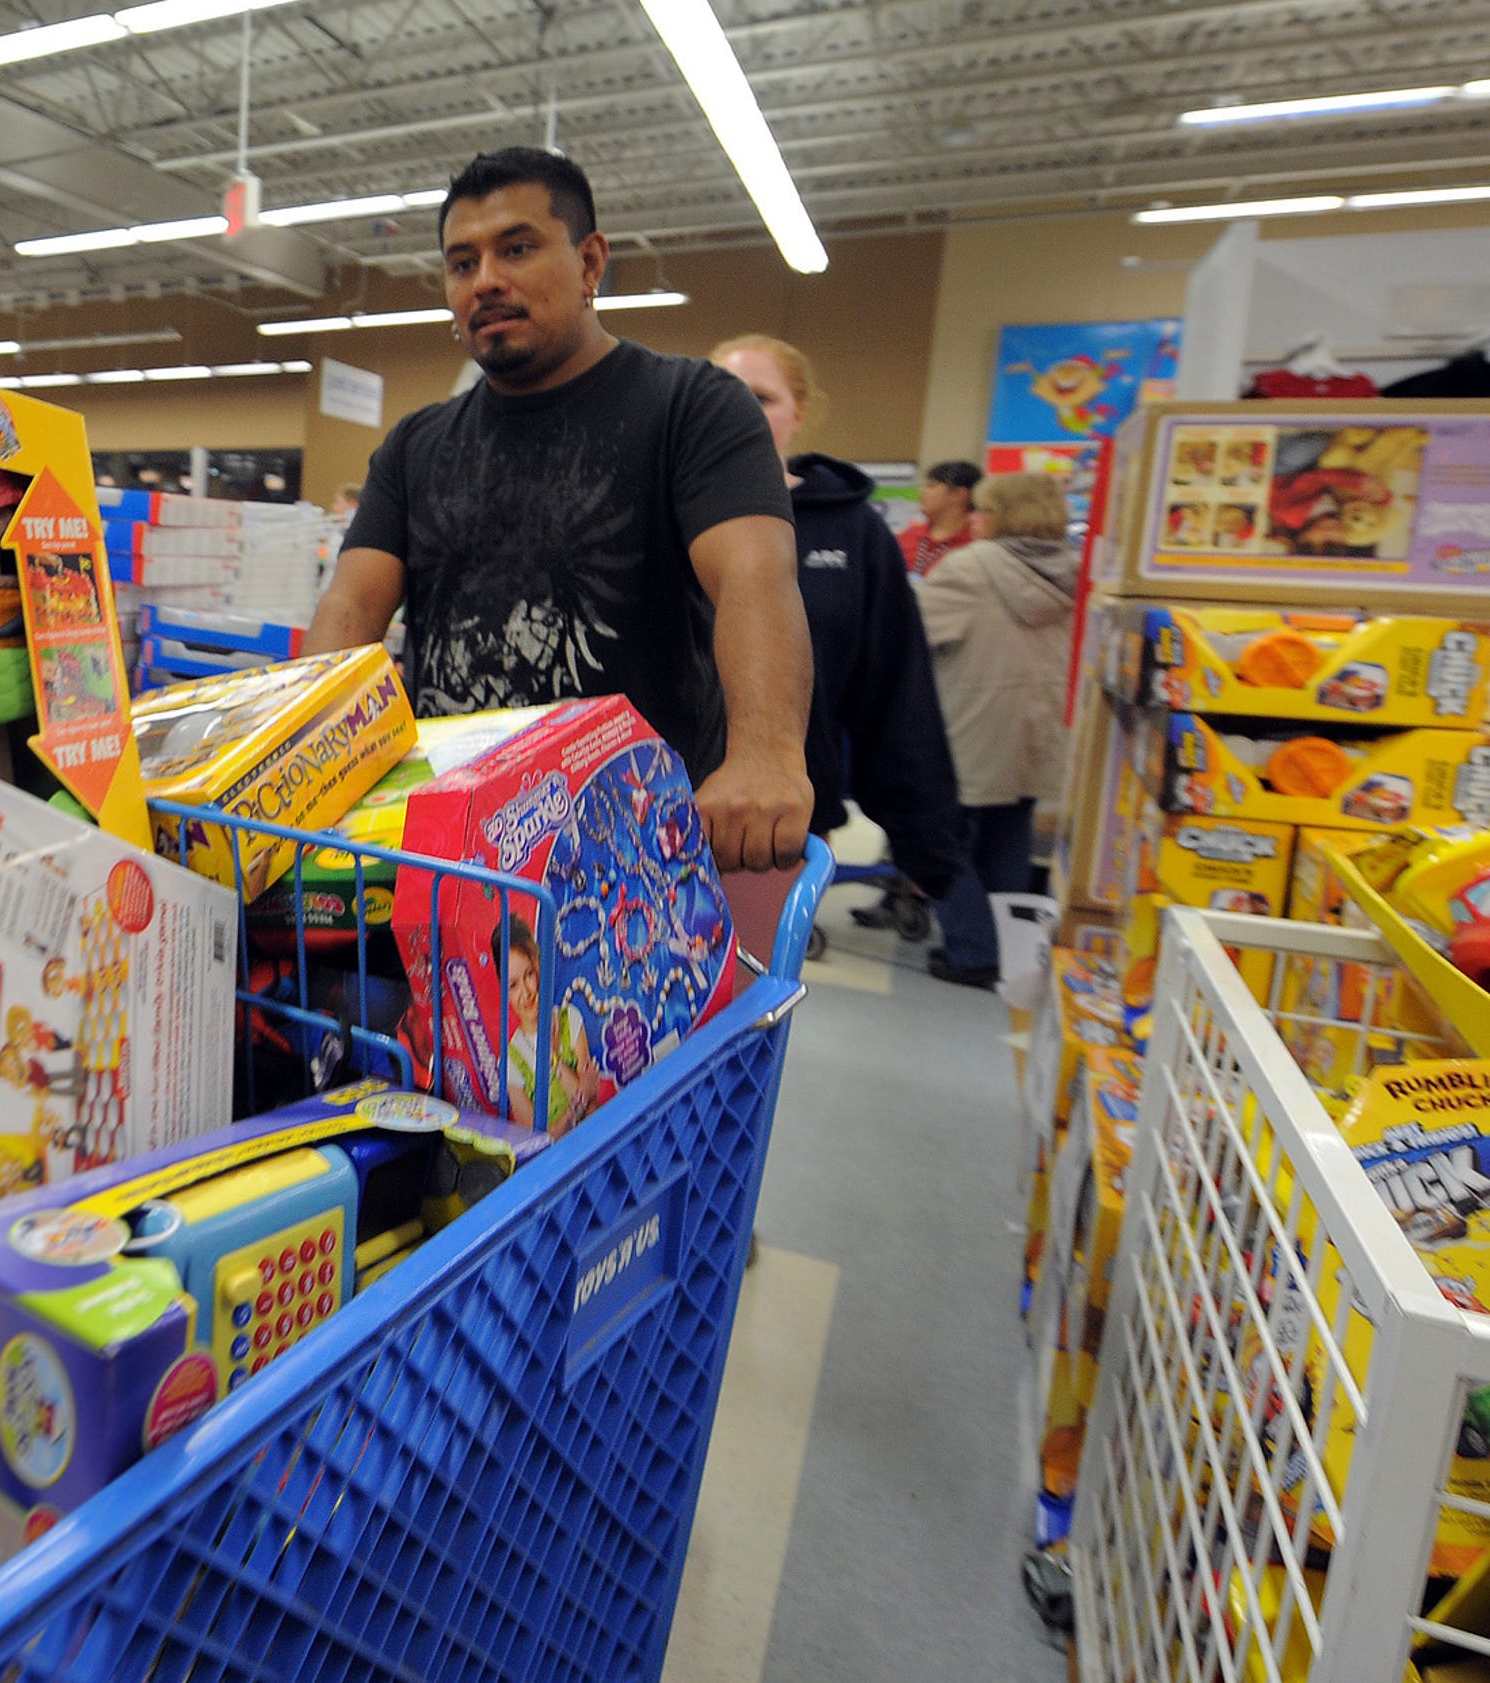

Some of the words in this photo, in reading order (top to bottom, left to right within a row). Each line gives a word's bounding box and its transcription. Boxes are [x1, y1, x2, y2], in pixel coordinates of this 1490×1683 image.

[21, 516, 55, 541] TRY
[58, 516, 89, 540] ME!
[1427, 630, 1479, 716] CHUCK
[53, 740, 87, 769] TRY
[91, 733, 121, 760] ME!
[1177, 825, 1279, 863] CHUCK
[574, 1247, 618, 1315] TOYS
[635, 1214, 661, 1258] US
